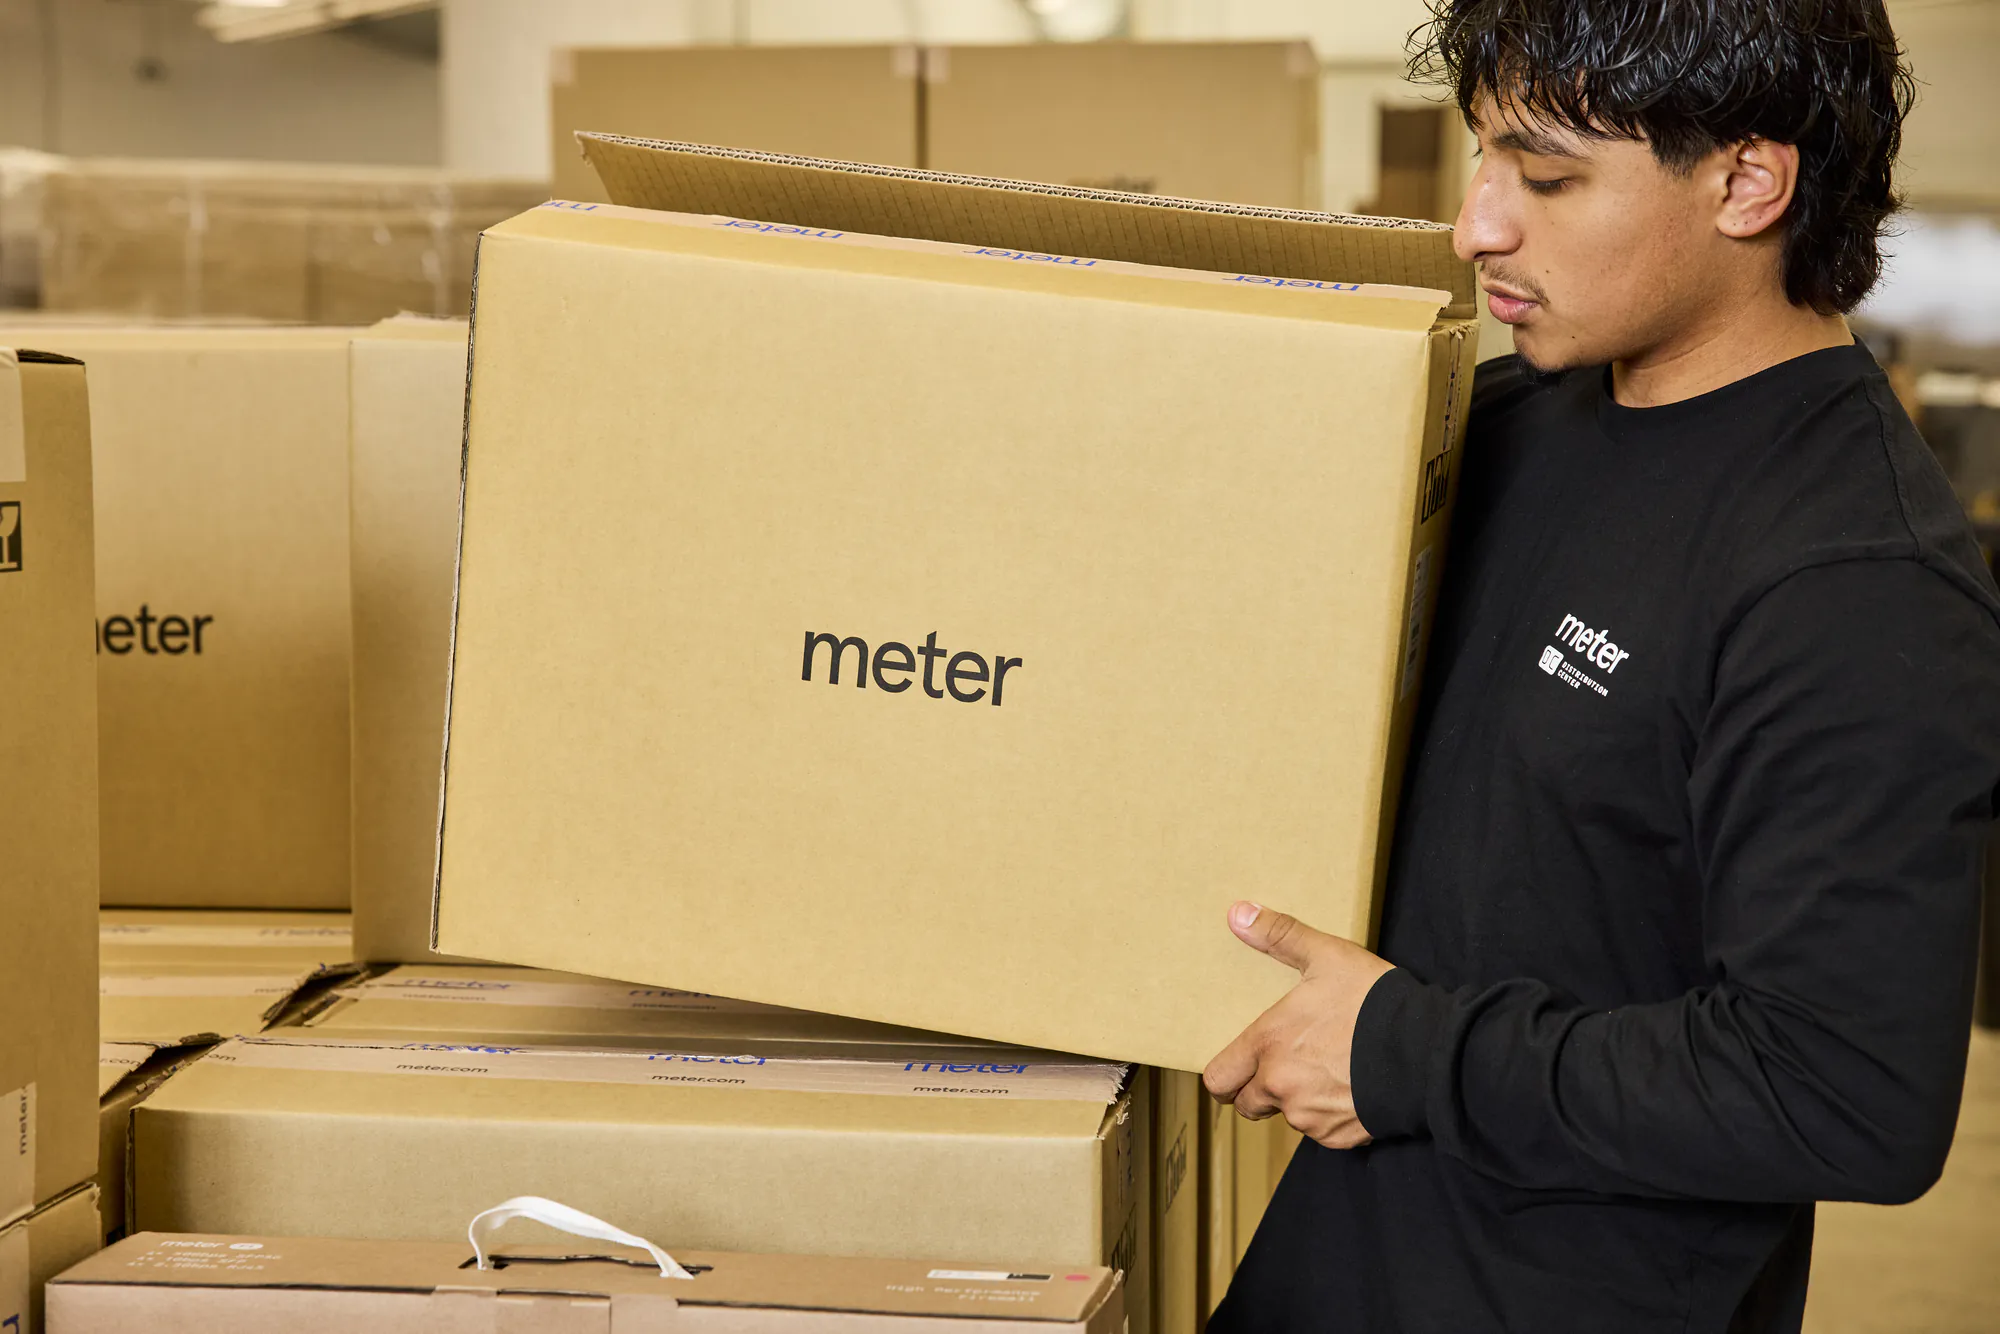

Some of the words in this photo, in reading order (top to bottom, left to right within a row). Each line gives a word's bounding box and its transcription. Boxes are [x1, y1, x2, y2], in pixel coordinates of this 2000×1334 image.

[712, 220, 844, 239] meter
[962, 248, 1097, 267] meter
[1222, 275, 1360, 292] meter
[95, 602, 214, 655] eter
[1555, 614, 1630, 674] meter
[802, 631, 1023, 706] meter
[1557, 669, 1581, 689] CENTER
[1561, 661, 1609, 697] DISTRIBUTION
[396, 1064, 489, 1073] meter.com
[904, 1063, 1030, 1074] meter
[651, 1075, 746, 1084] meter.com
[913, 1086, 1009, 1094] meter.com
[160, 1240, 224, 1248] meter
